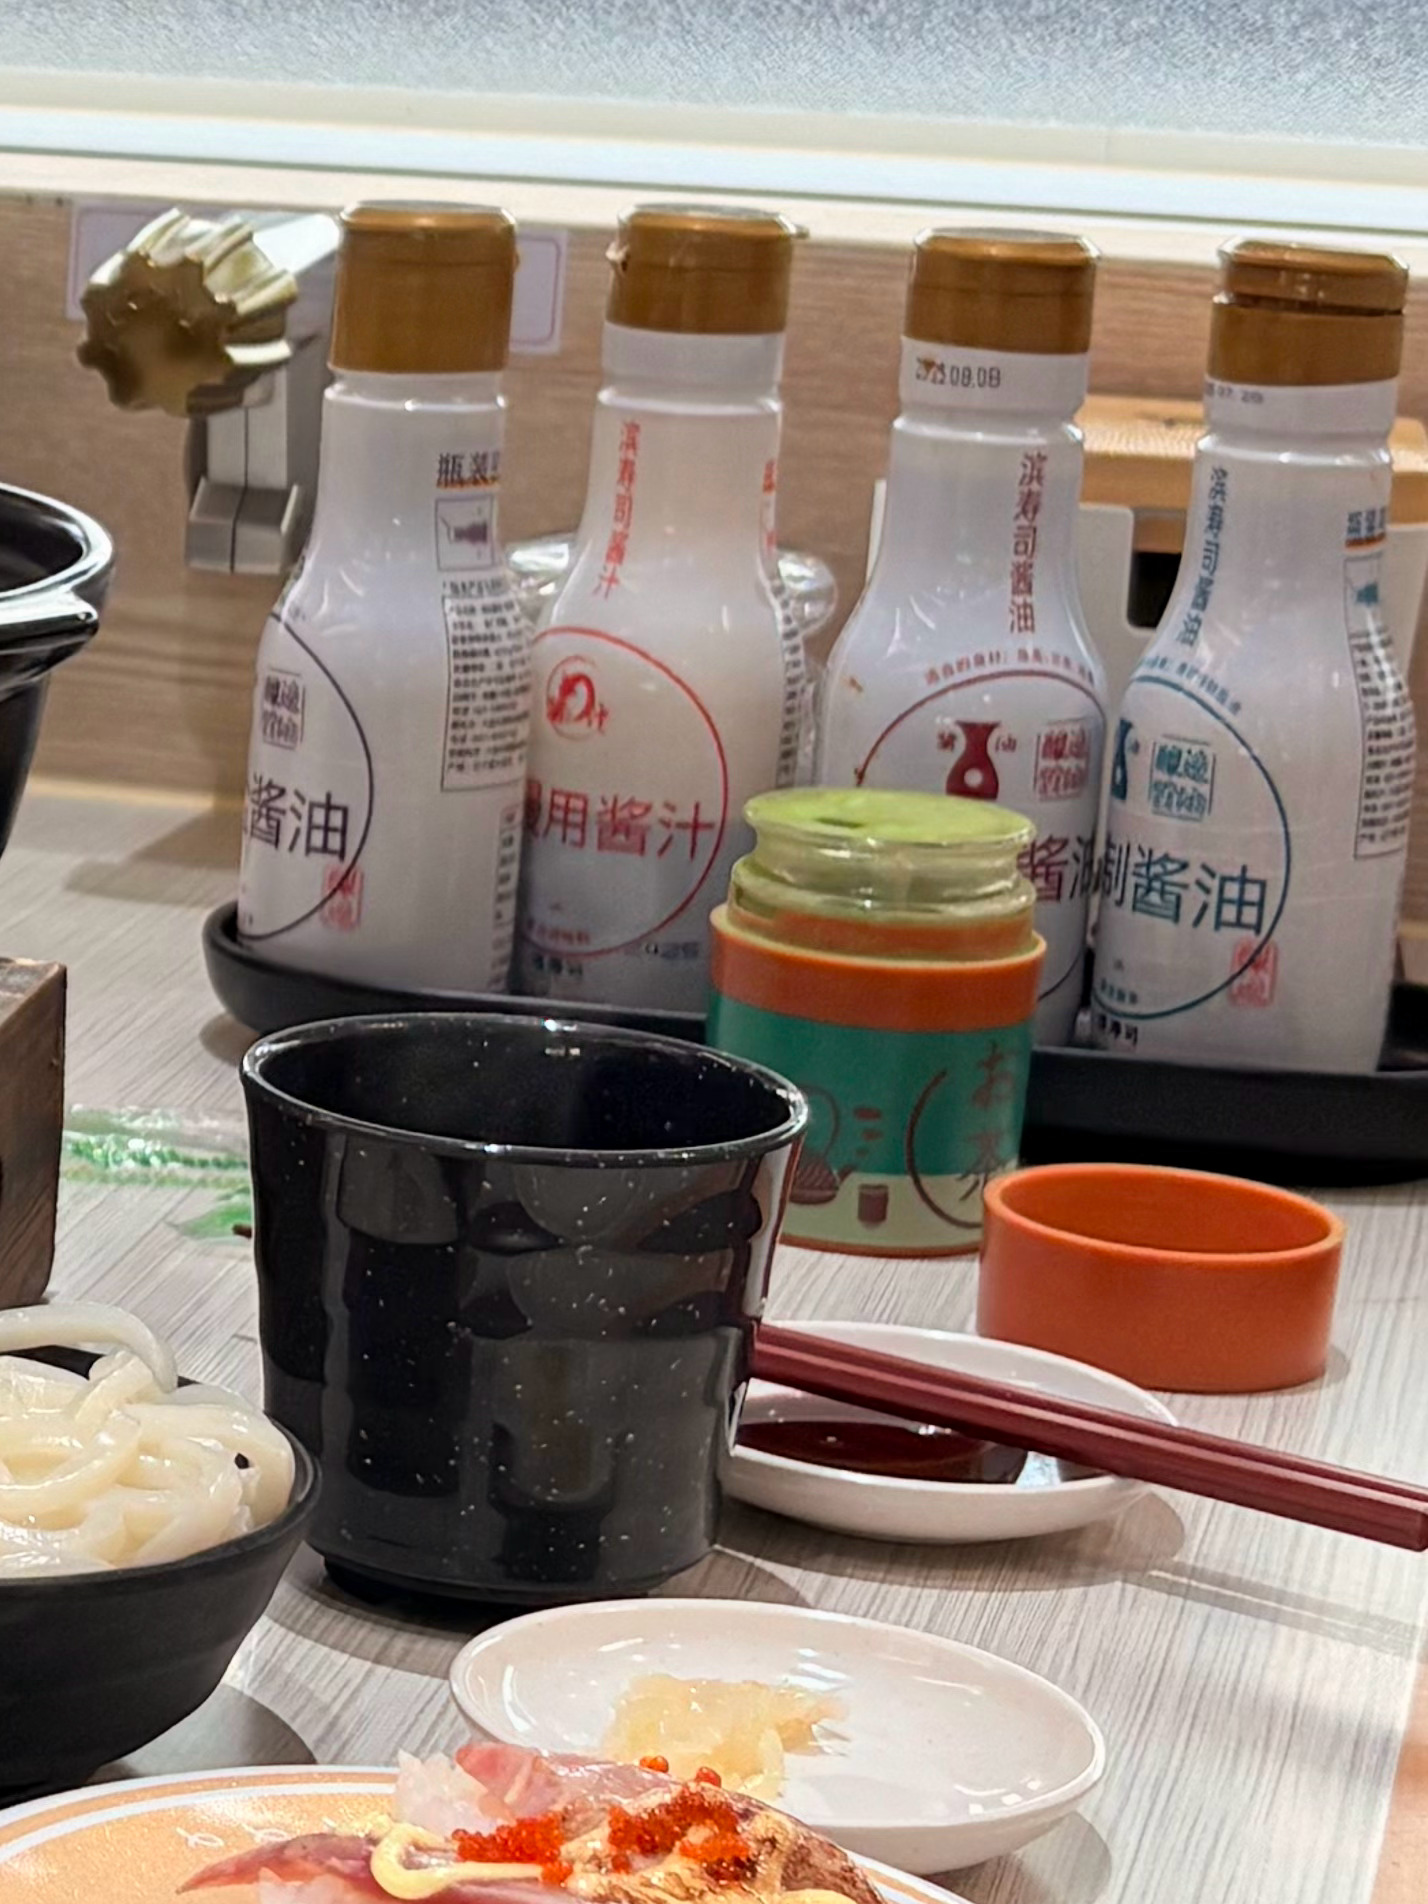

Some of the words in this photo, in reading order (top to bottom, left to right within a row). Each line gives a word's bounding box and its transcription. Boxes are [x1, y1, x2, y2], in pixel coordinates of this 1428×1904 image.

[1010, 452, 1050, 634] 滨寿司酱油
[243, 772, 350, 862] 酱油
